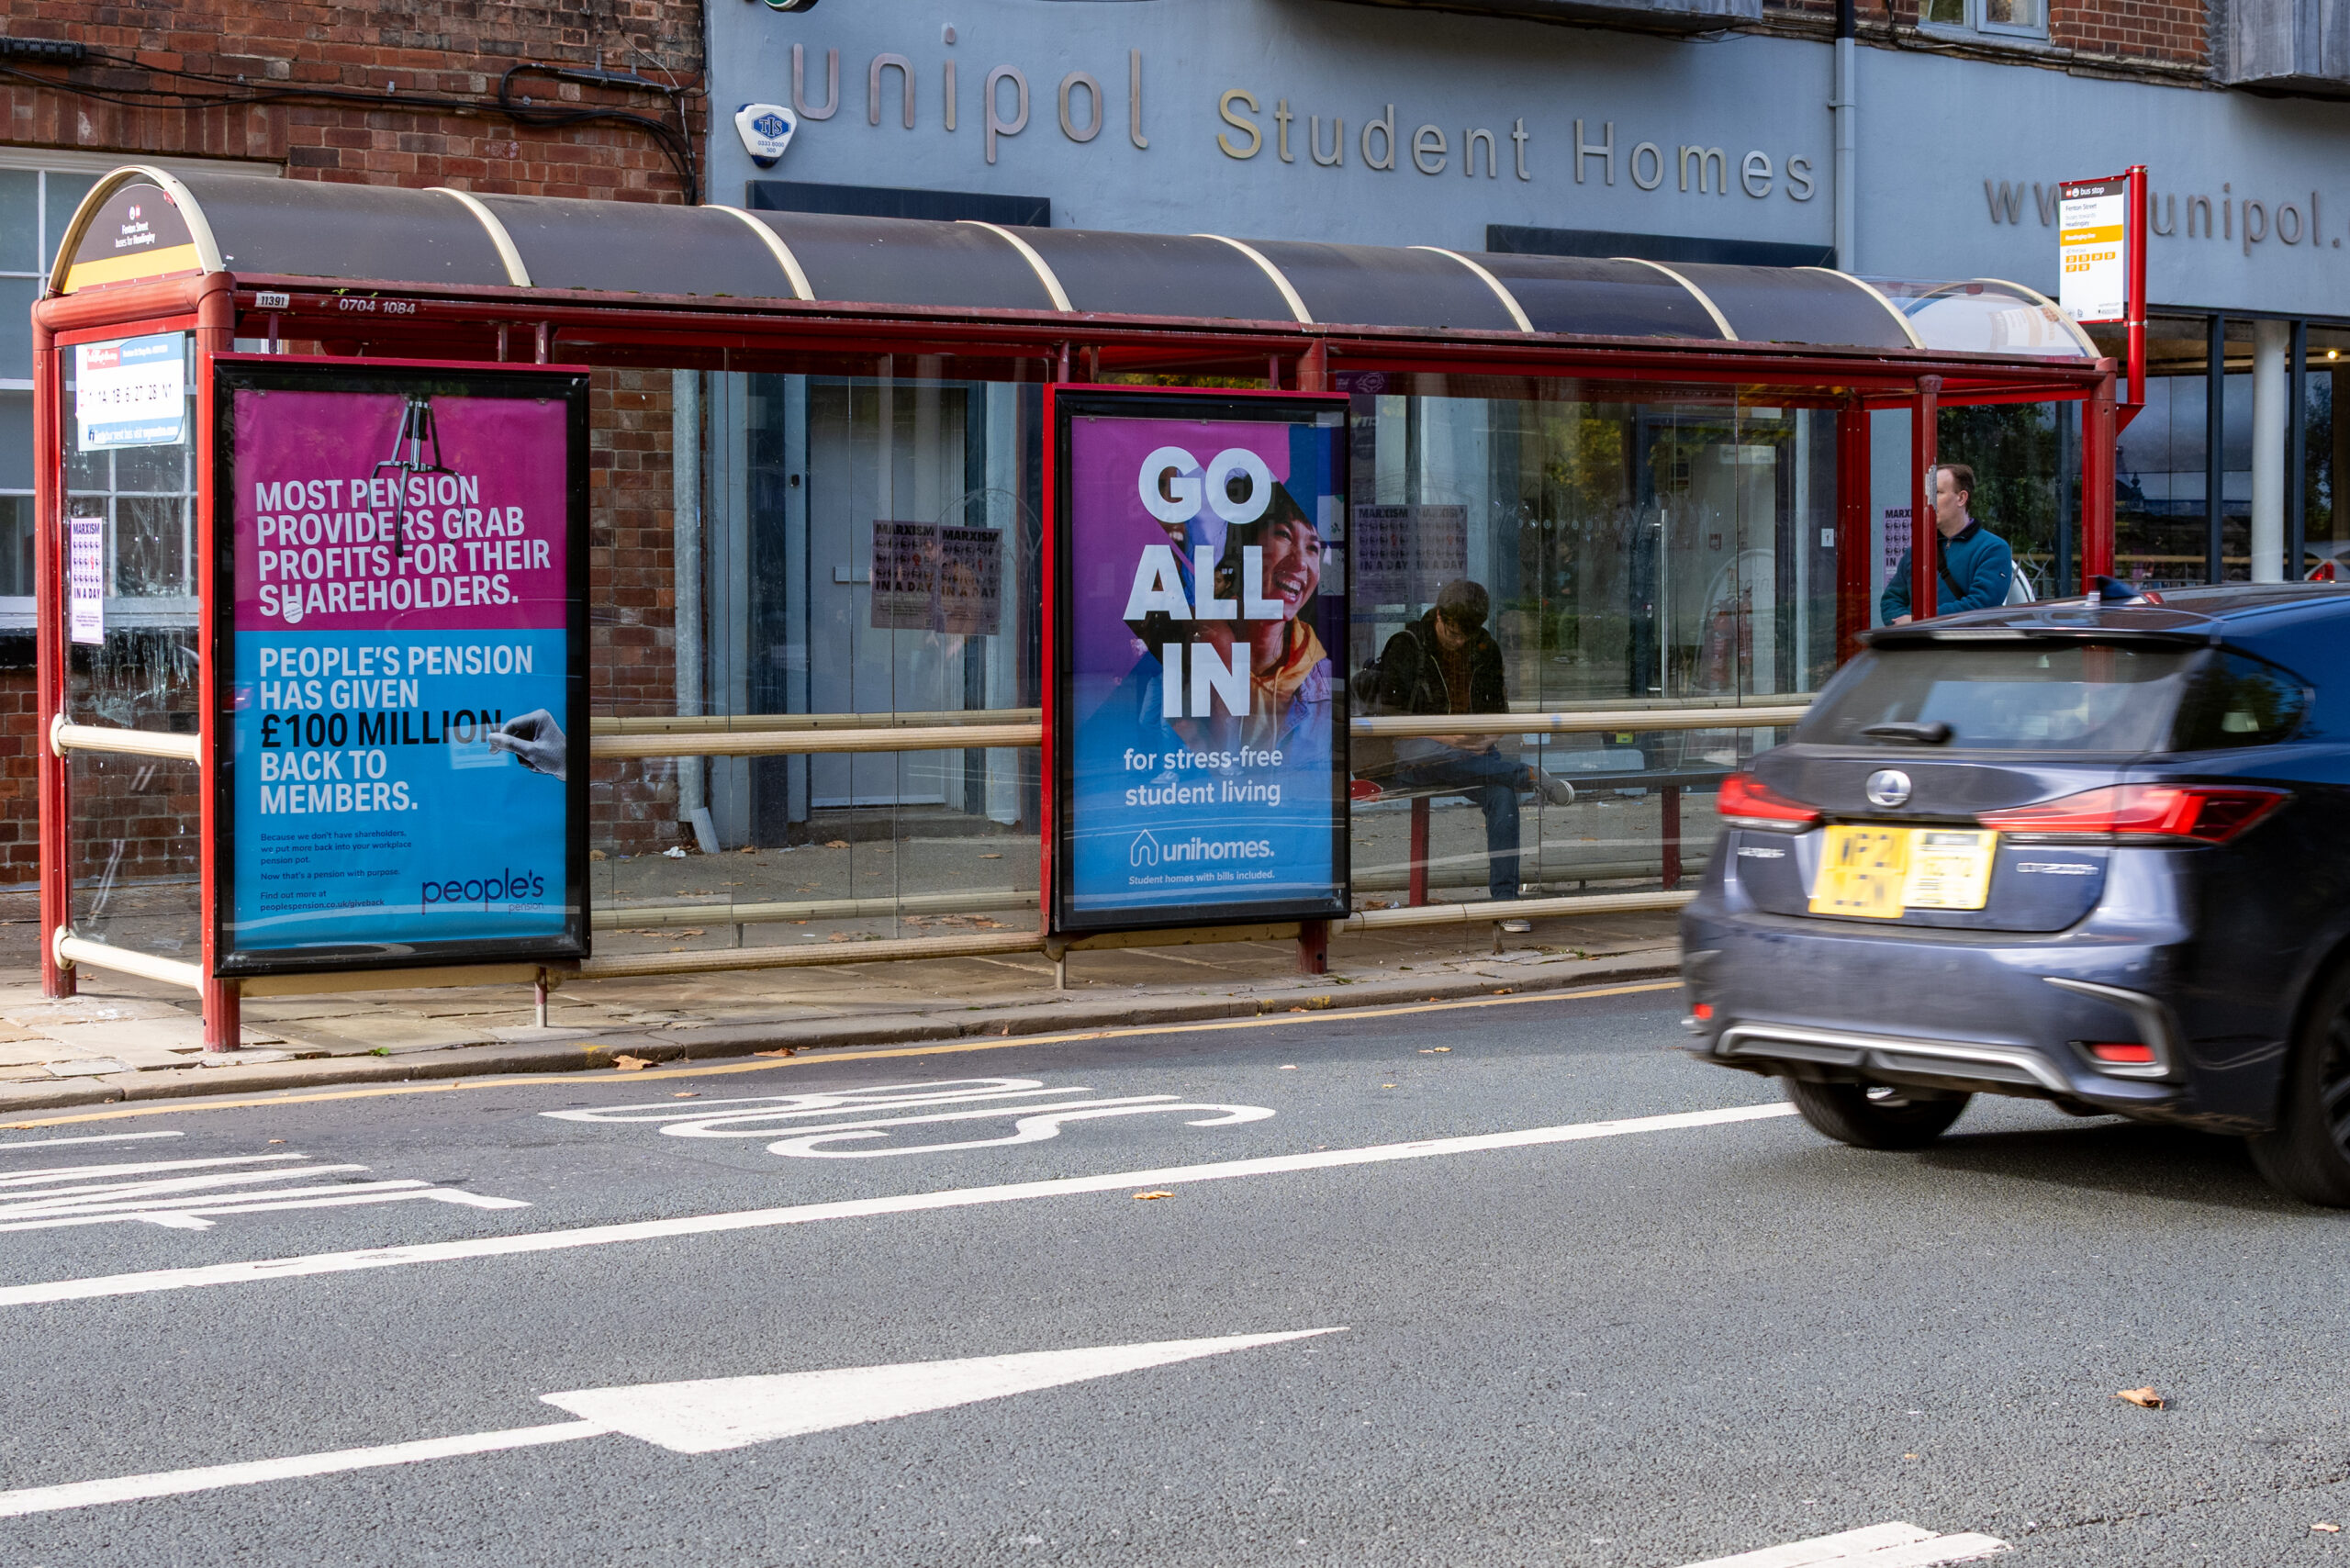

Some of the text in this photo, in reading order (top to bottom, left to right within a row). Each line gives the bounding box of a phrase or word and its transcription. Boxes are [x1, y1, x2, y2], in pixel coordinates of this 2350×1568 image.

[793, 22, 1148, 164] unipol
[758, 117, 782, 137] TIS
[1217, 88, 1817, 201] Student Homes
[2080, 186, 2105, 196] bus stop
[136, 221, 149, 232] Street
[261, 295, 285, 307] 11391
[339, 298, 416, 315] 0704 1084
[1138, 446, 1272, 524] GO
[255, 476, 479, 512] MOST PENSION
[1359, 509, 1408, 518] MARXISM
[73, 522, 100, 534] MARXISM
[257, 506, 525, 546] PROVIDERS GRAB
[876, 523, 934, 537] MARXISM
[942, 530, 999, 543] MARXISM
[258, 539, 552, 581] PROFITS FOR THEIR
[1360, 560, 1408, 570] IN A DAY
[1886, 557, 1897, 566] IN
[876, 580, 934, 593] IN A DAY
[1123, 544, 1284, 621] ALL
[74, 588, 100, 599] IN A DAY
[259, 574, 519, 617] SHAREHOLDERS.
[260, 645, 533, 678] PEOPLE'S PENSION
[1162, 642, 1251, 718] IN
[261, 679, 419, 711] HAS GIVEN
[261, 710, 502, 748] £100 MILLION
[261, 749, 387, 782] BACK TO
[1124, 745, 1283, 771] for stress-free
[261, 781, 418, 815] MEMBERS.
[1125, 779, 1281, 807] student living
[261, 833, 296, 842] Because
[311, 831, 331, 840] don't
[333, 831, 352, 839] have
[275, 845, 290, 855] put
[314, 843, 334, 852] back
[335, 842, 351, 851] into
[352, 843, 370, 853] your
[372, 841, 412, 851] workplace
[1162, 836, 1275, 862] unihomes.
[261, 856, 311, 866] pension pot.
[261, 872, 280, 880] Now
[282, 871, 306, 879] that's
[313, 869, 345, 880] pension
[347, 868, 365, 877] with
[367, 868, 400, 879] purpose.
[1128, 869, 1275, 885] Student homes with bills included.
[261, 891, 278, 900] Find
[319, 890, 327, 898] at
[421, 868, 544, 915] people's
[261, 898, 385, 913] peoplespension.co.uk/giveback
[509, 902, 544, 915] pension
